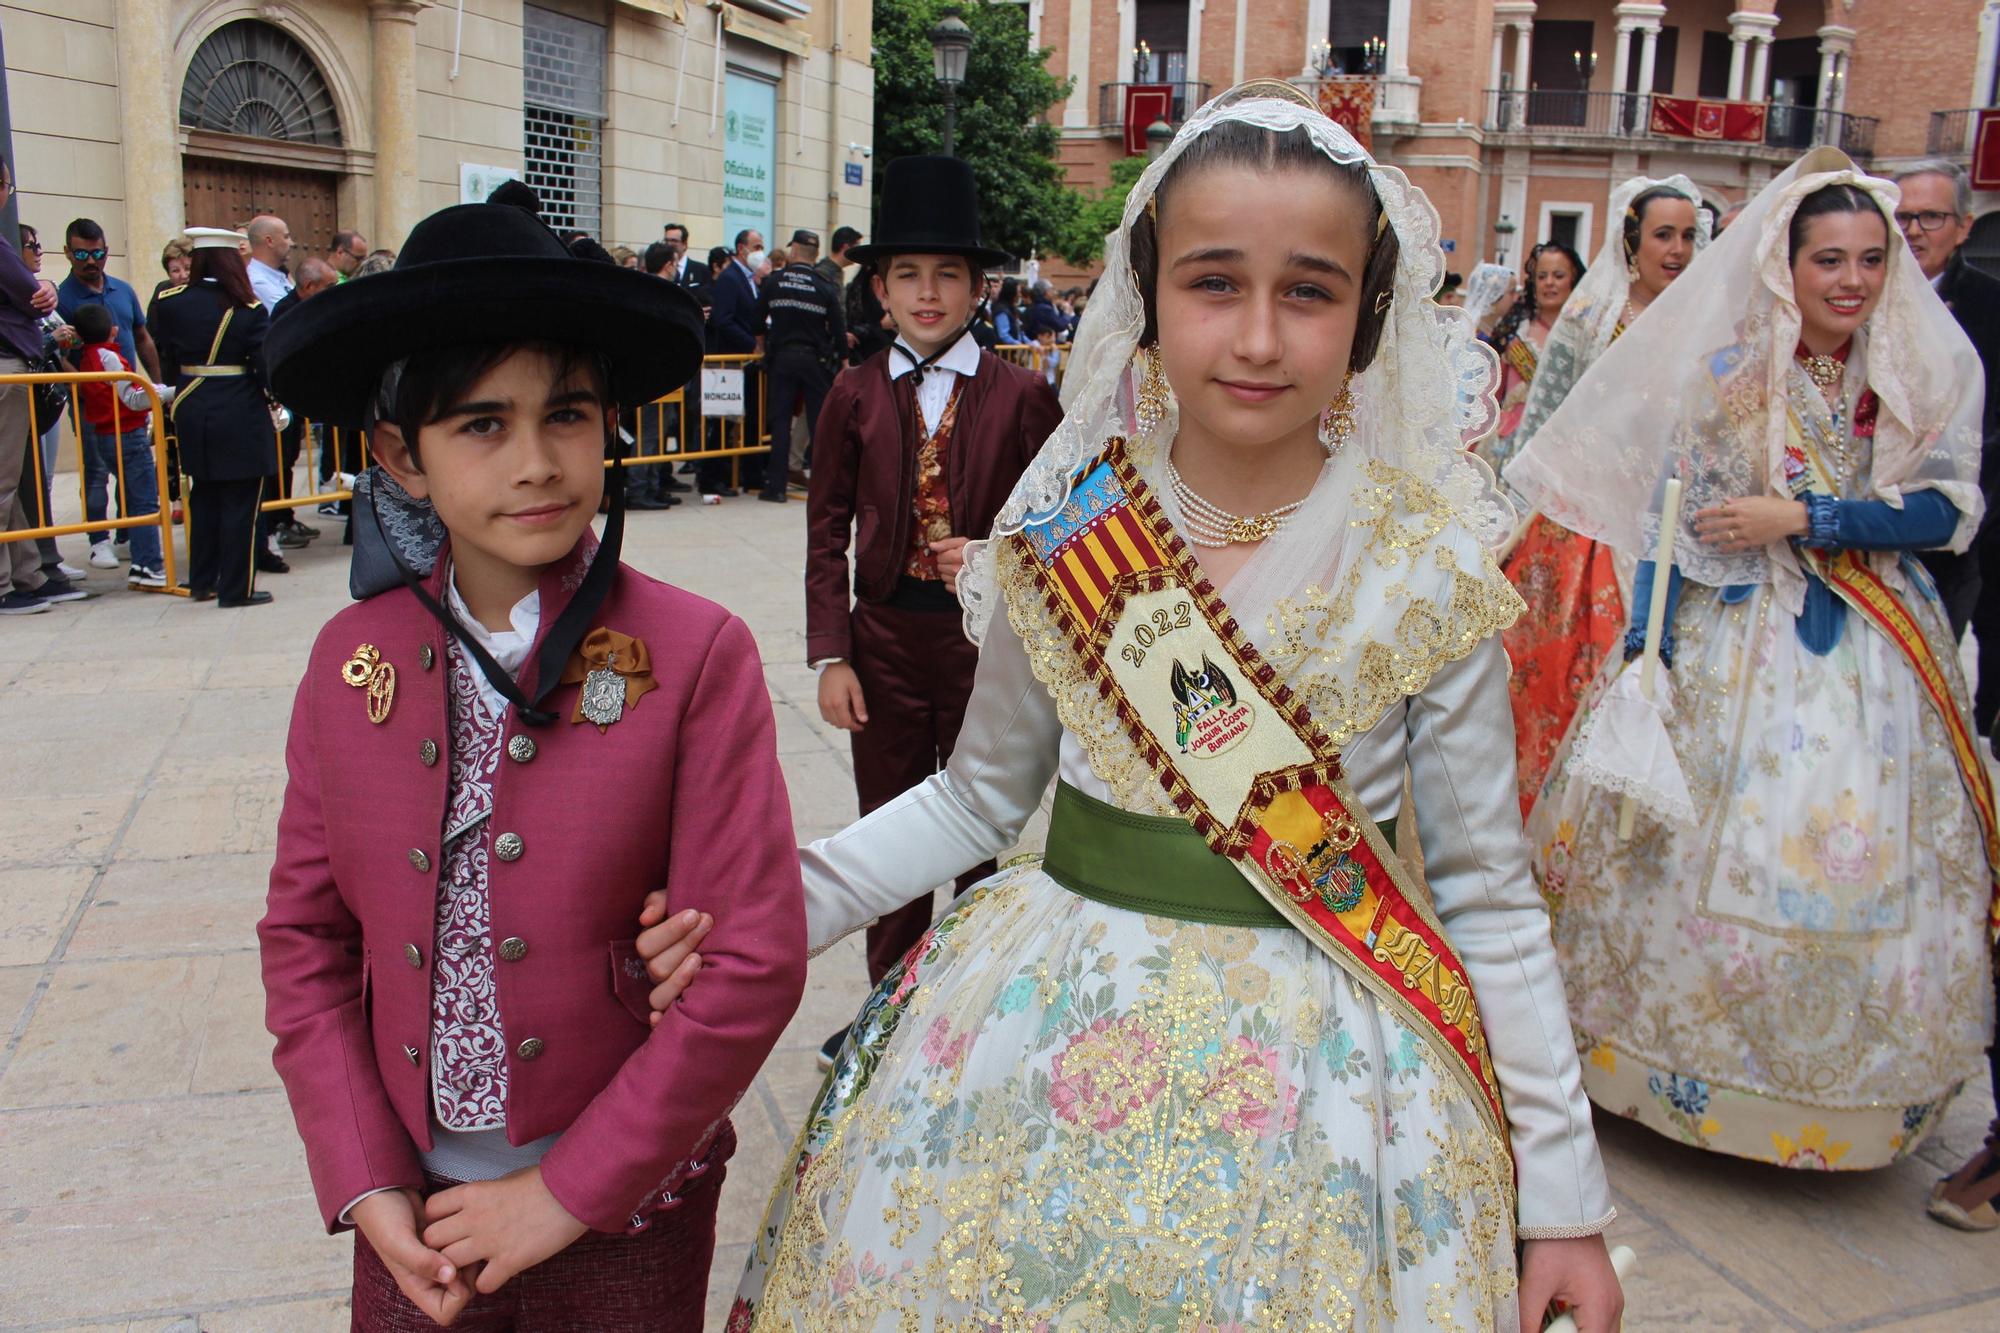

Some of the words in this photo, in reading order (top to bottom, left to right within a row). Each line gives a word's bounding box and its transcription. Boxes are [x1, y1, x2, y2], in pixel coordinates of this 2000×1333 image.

[724, 160, 754, 178] Oficina
[755, 164, 766, 181] de
[724, 183, 765, 202] Atención
[778, 281, 816, 292] VALENCIA
[721, 375, 726, 384] A
[704, 392, 742, 401] MONCADA
[1121, 601, 1191, 668] 2022
[1191, 724, 1223, 752] JOAQUIN
[1222, 706, 1249, 729] COSTA
[1196, 708, 1228, 733] FALLA
[1207, 721, 1248, 753] BURRIANA
